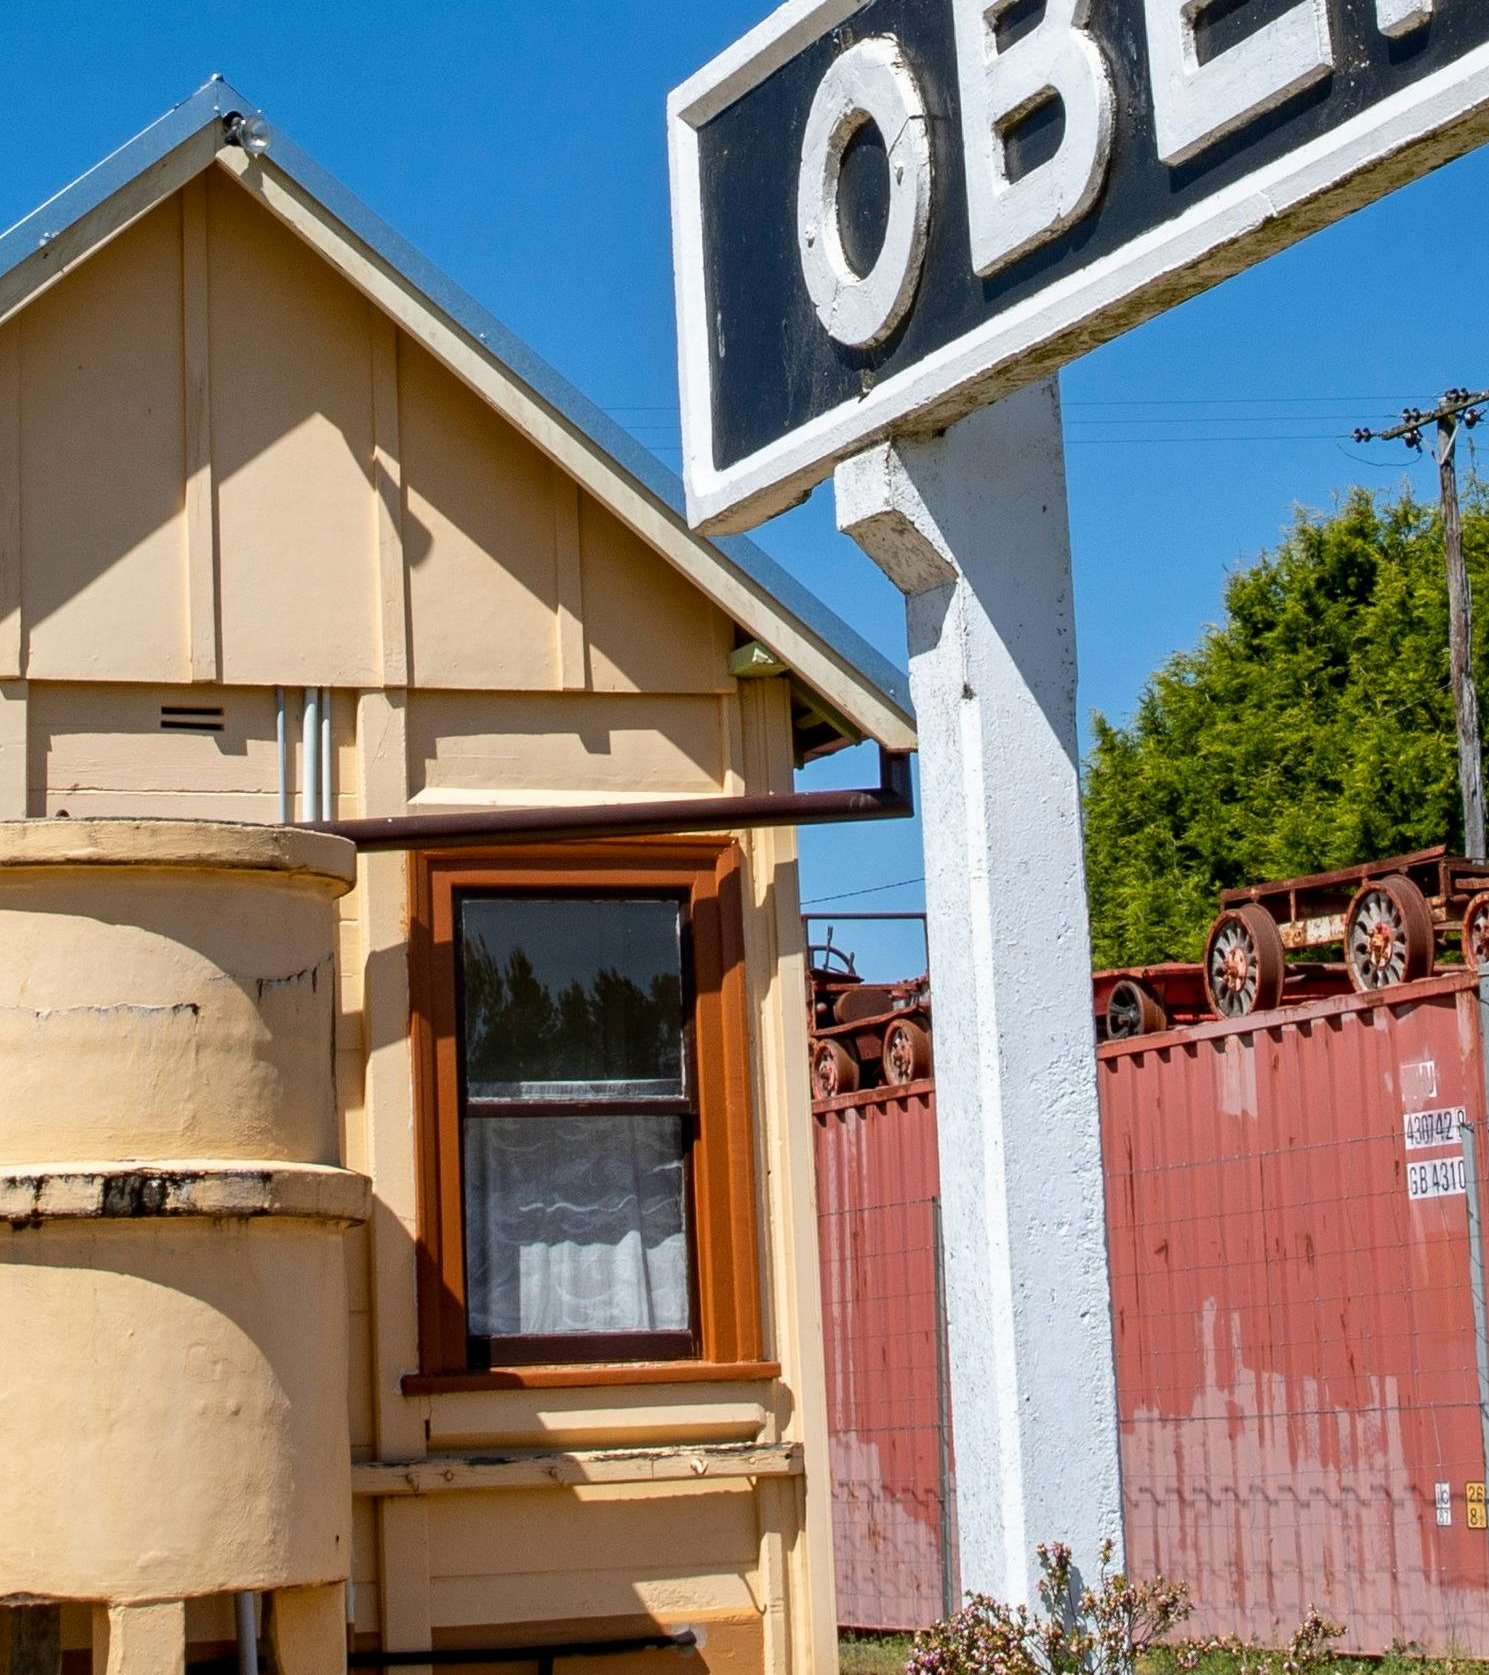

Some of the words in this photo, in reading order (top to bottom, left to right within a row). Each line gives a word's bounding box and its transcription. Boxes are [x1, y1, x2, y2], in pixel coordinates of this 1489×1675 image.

[1406, 1110, 1454, 1145] 430742
[1409, 1165, 1428, 1195] GB
[1432, 1160, 1467, 1193] 4310
